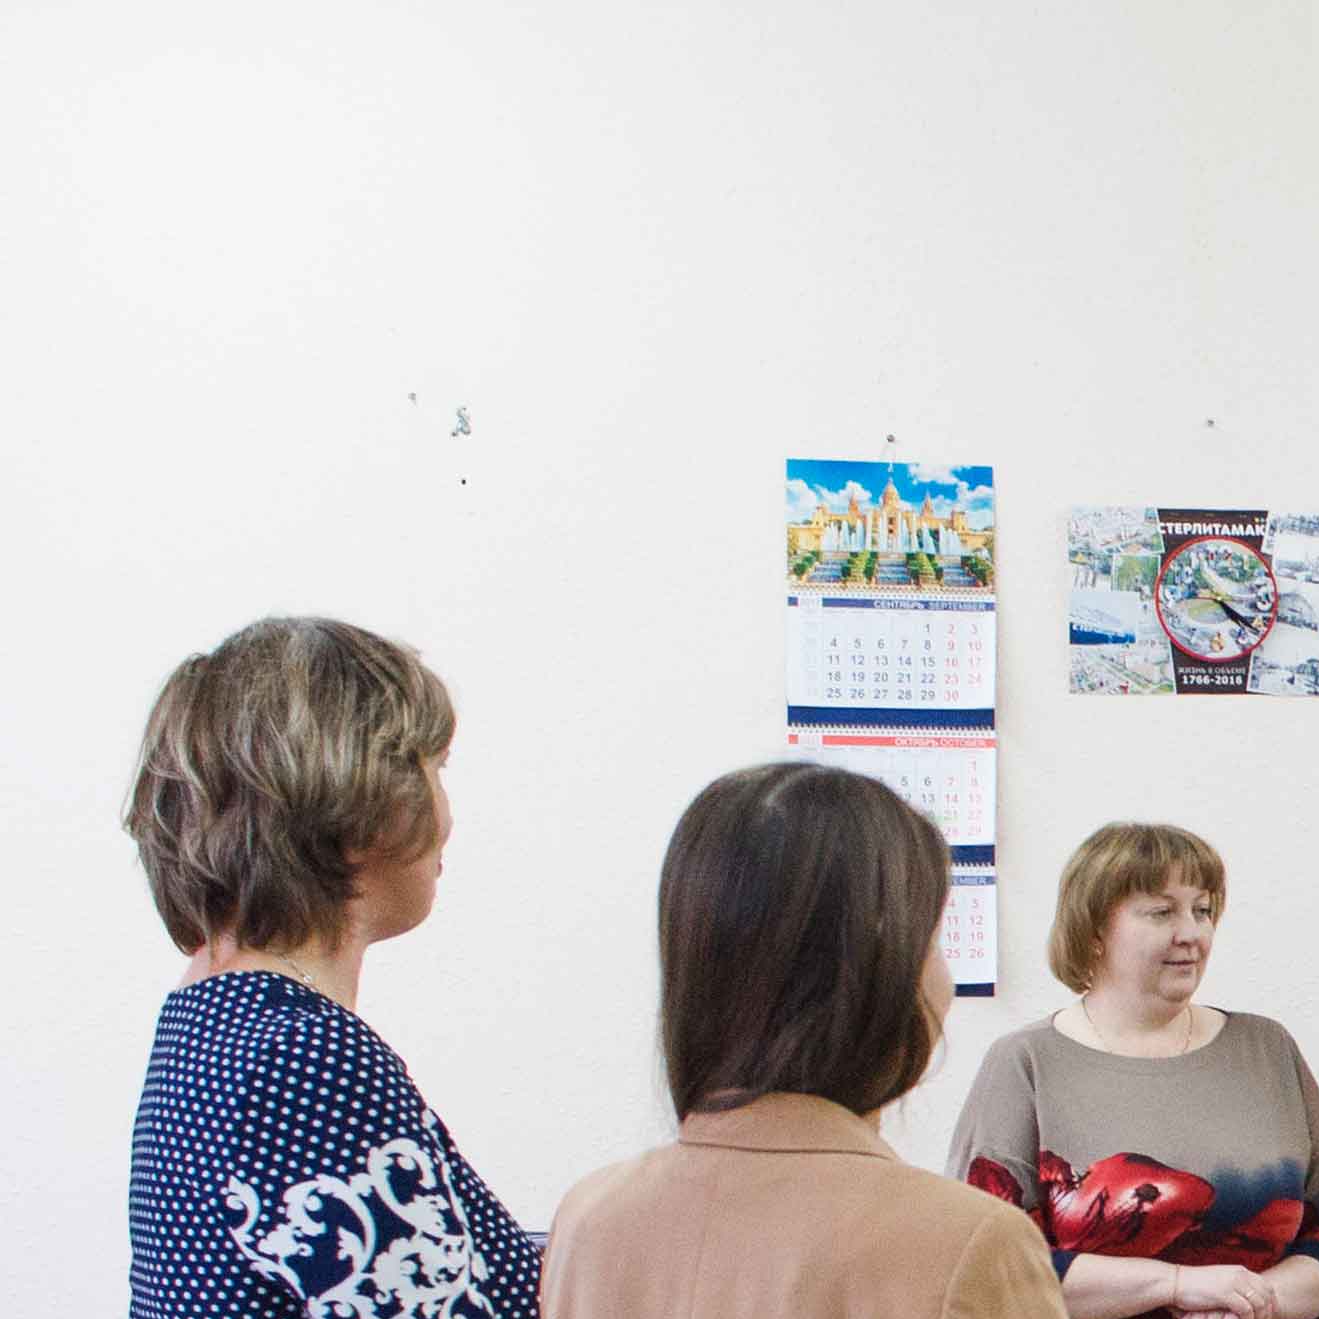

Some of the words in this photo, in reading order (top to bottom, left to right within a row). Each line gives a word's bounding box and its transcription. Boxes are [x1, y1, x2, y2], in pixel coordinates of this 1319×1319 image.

[1158, 522, 1265, 536] СТЕРЛИТАМАК
[924, 623, 931, 634] 1
[830, 637, 837, 647] 4
[854, 638, 861, 649] 5
[877, 638, 884, 649] 6
[901, 639, 909, 650] 7
[924, 640, 931, 651] 8
[828, 654, 839, 664] 11
[851, 655, 864, 665] 12
[875, 655, 888, 666] 13
[898, 656, 912, 666] 14
[921, 656, 935, 667] 15
[828, 671, 841, 681] 18
[852, 672, 865, 682] 19
[874, 672, 888, 682] 20
[897, 672, 911, 683] 21
[921, 673, 935, 684] 22
[827, 688, 842, 698] 25
[851, 689, 865, 699] 26
[874, 688, 888, 699] 27
[898, 689, 912, 700] 28
[920, 690, 935, 701] 29
[924, 776, 932, 786] 6
